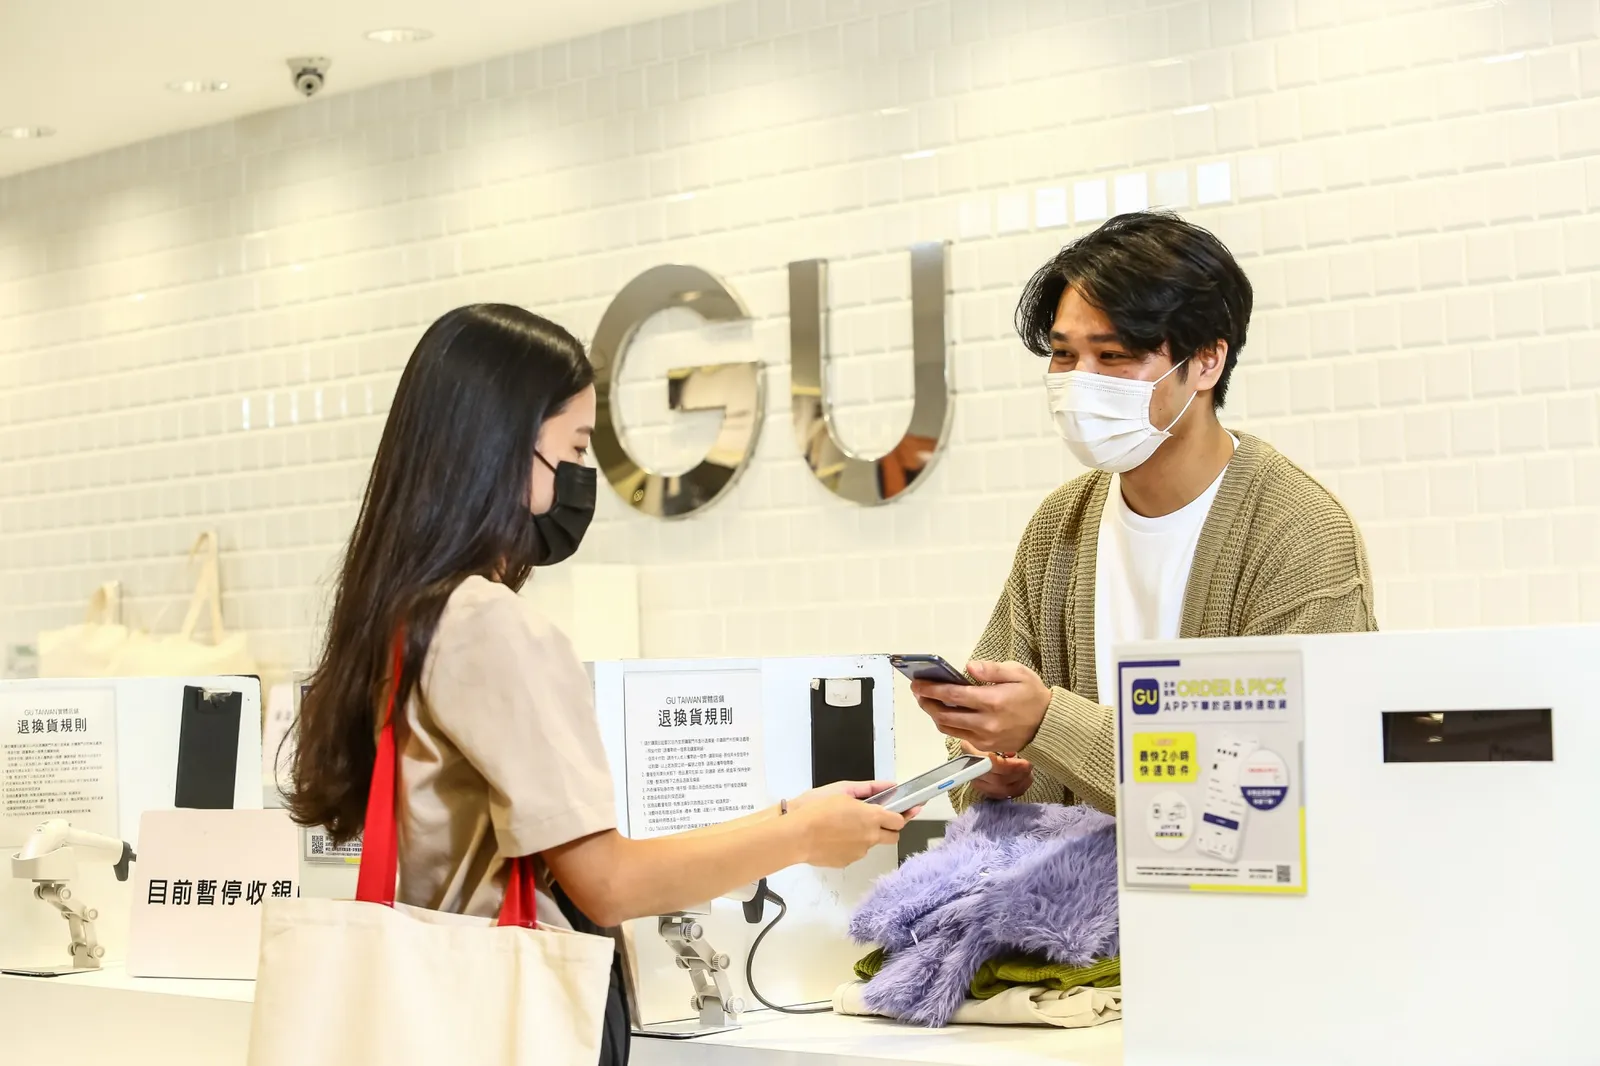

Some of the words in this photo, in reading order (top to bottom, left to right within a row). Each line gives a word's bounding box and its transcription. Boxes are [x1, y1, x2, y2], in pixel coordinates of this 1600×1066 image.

[590, 240, 954, 519] GU
[1177, 679, 1232, 697] ORDER
[1234, 678, 1245, 696] &
[1248, 677, 1287, 696] PICK
[1133, 689, 1158, 705] GU
[17, 717, 87, 734] 退換貨規則
[658, 707, 733, 727] 退換貨規則
[1140, 751, 1189, 762] 最快2小時
[1140, 765, 1189, 776] 快速取件
[147, 879, 300, 905] 目前暫停收銀
